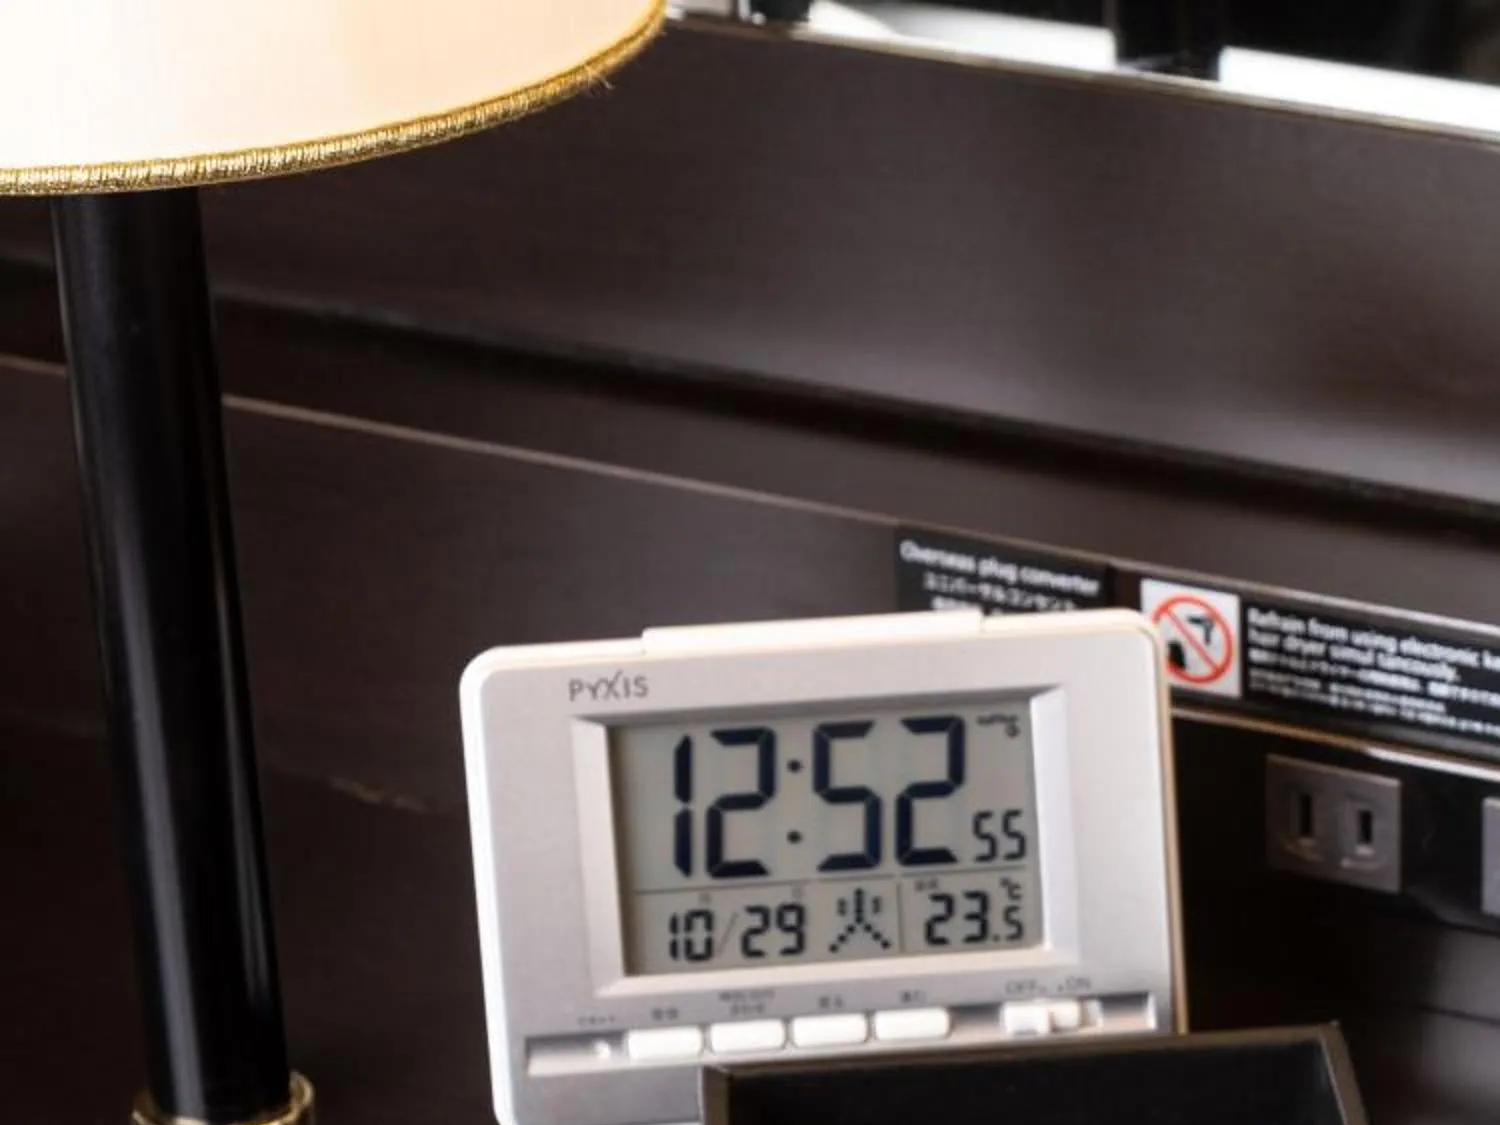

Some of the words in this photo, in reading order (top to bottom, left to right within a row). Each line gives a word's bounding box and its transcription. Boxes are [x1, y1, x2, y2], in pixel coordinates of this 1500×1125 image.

[900, 539, 975, 573] Overseas
[979, 557, 1018, 582] plug
[1249, 607, 1305, 634] Refrain
[1308, 618, 1349, 642] from
[1350, 630, 1397, 654] using
[1400, 637, 1480, 668] electronic
[569, 668, 649, 702] PYXIS
[673, 715, 966, 879] 12:52
[973, 809, 1026, 863] 55
[669, 903, 806, 962] 10/29
[924, 890, 1023, 945] 23.5
